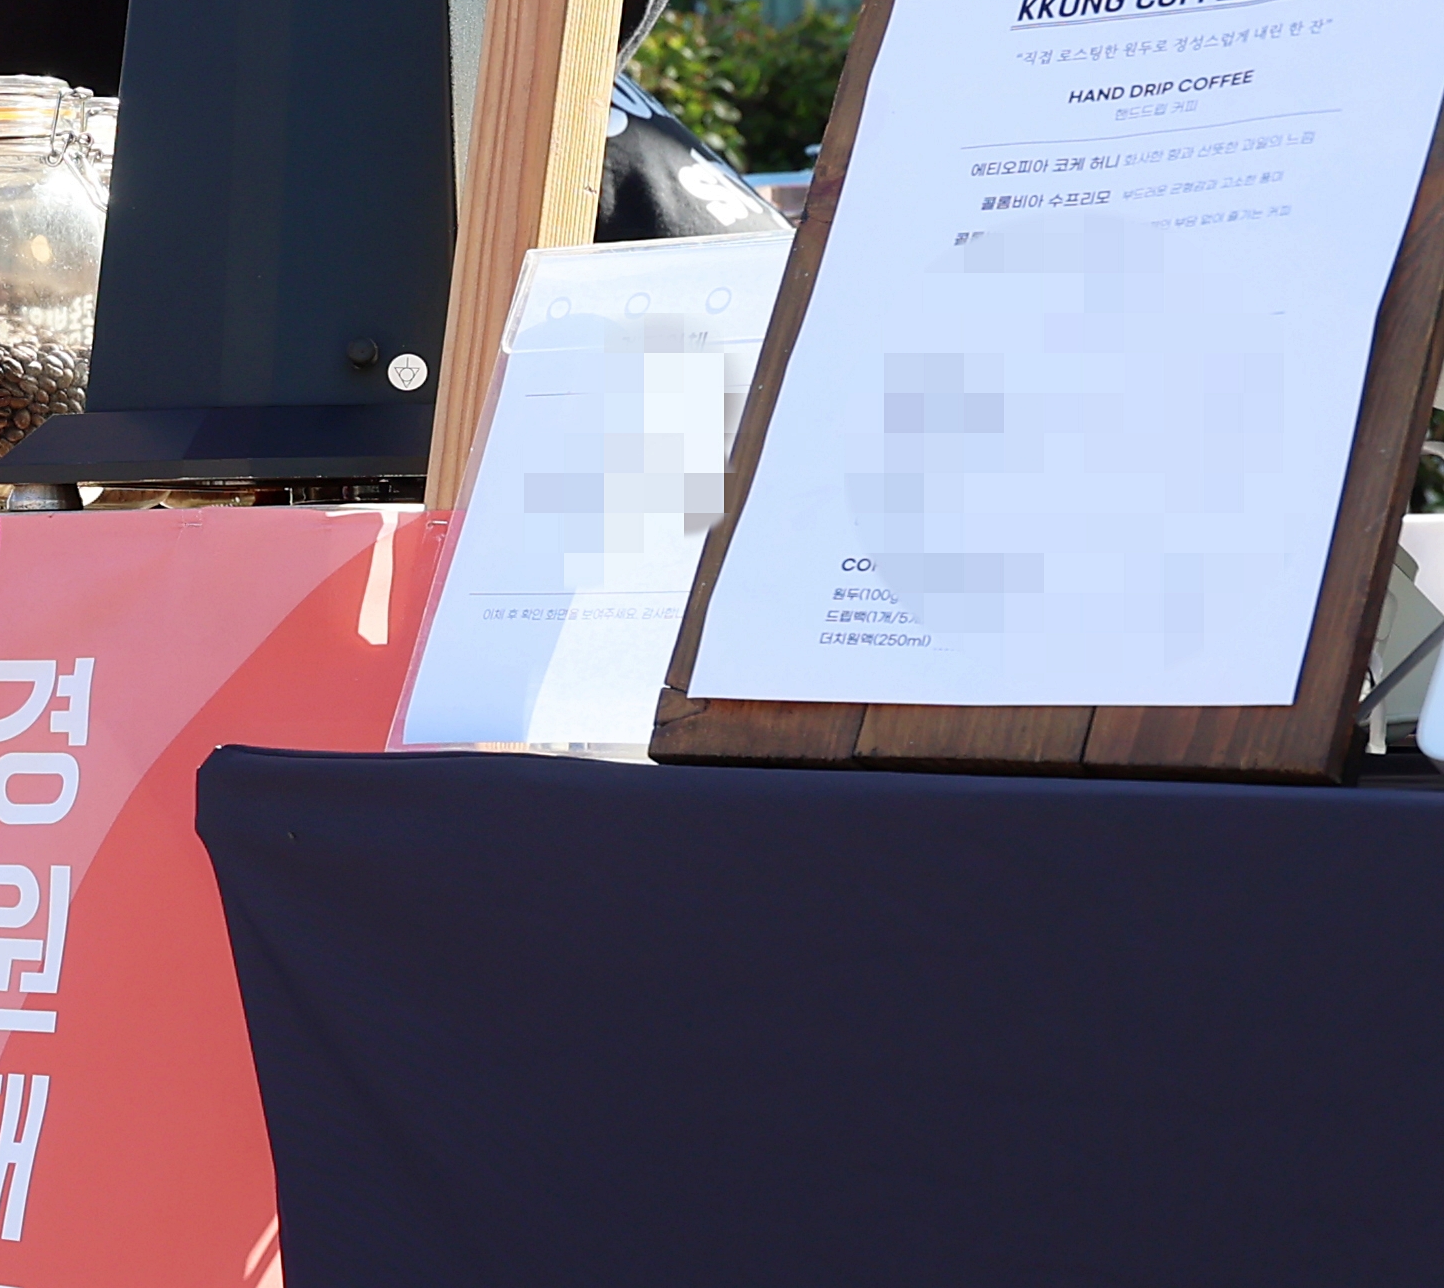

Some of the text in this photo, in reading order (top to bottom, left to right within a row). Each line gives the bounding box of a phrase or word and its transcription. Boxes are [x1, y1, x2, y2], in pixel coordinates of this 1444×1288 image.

[1056, 44, 1119, 63] 로스팅한
[1123, 39, 1168, 57] 원두로
[1173, 28, 1250, 54] 정성스럽게
[1254, 22, 1283, 40] 내린
[1289, 21, 1303, 36] 한
[1068, 69, 1255, 104] HAND DRIP COFFEE
[1171, 99, 1199, 114] 커피
[970, 159, 1049, 178] 에티오피아
[1051, 156, 1086, 174] 코케
[1089, 153, 1121, 171] 허니
[980, 194, 1044, 211] 콜롬비아
[1047, 189, 1112, 208] 수프리모
